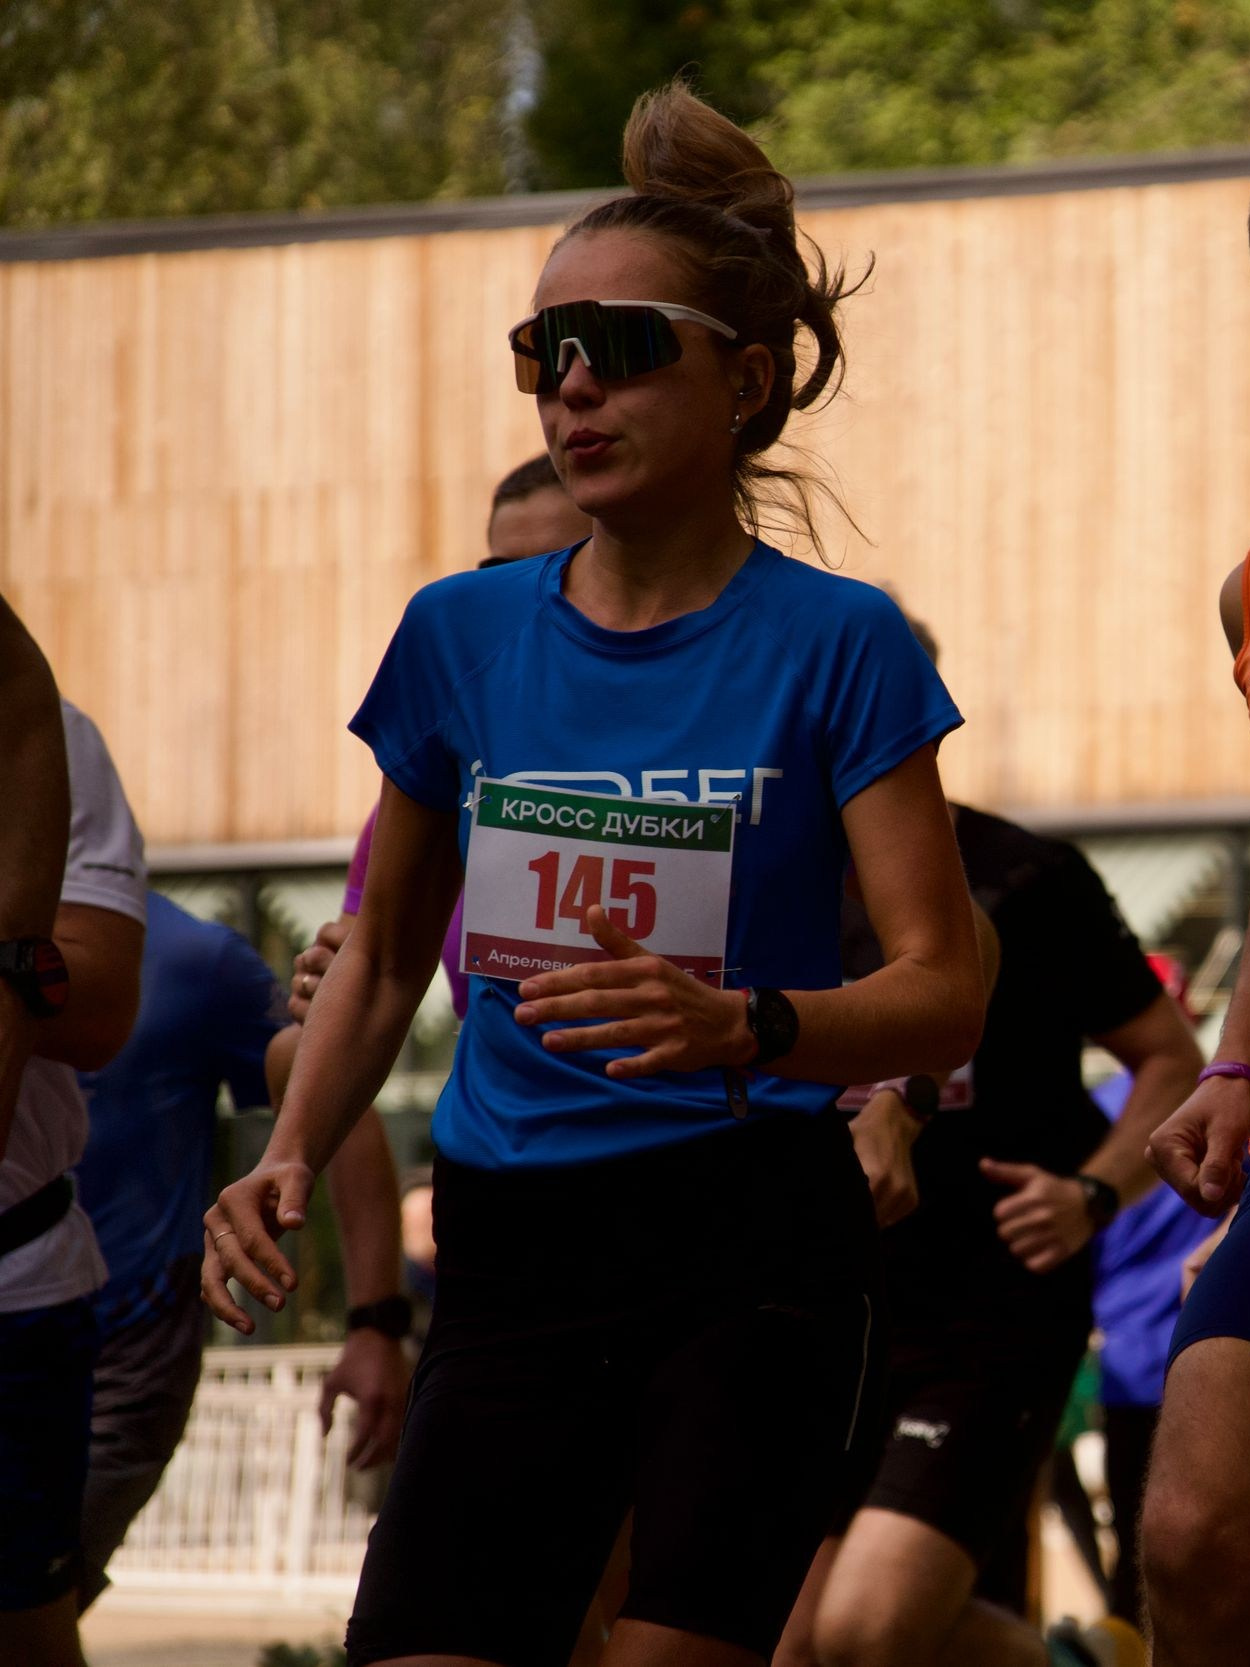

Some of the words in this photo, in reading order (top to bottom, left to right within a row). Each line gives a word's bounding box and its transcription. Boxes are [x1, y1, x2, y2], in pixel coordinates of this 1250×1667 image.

[501, 797, 597, 831] КРОСС
[601, 811, 704, 841] ДУБКИ
[528, 850, 657, 941] 145
[487, 947, 577, 971] Апрелевк
